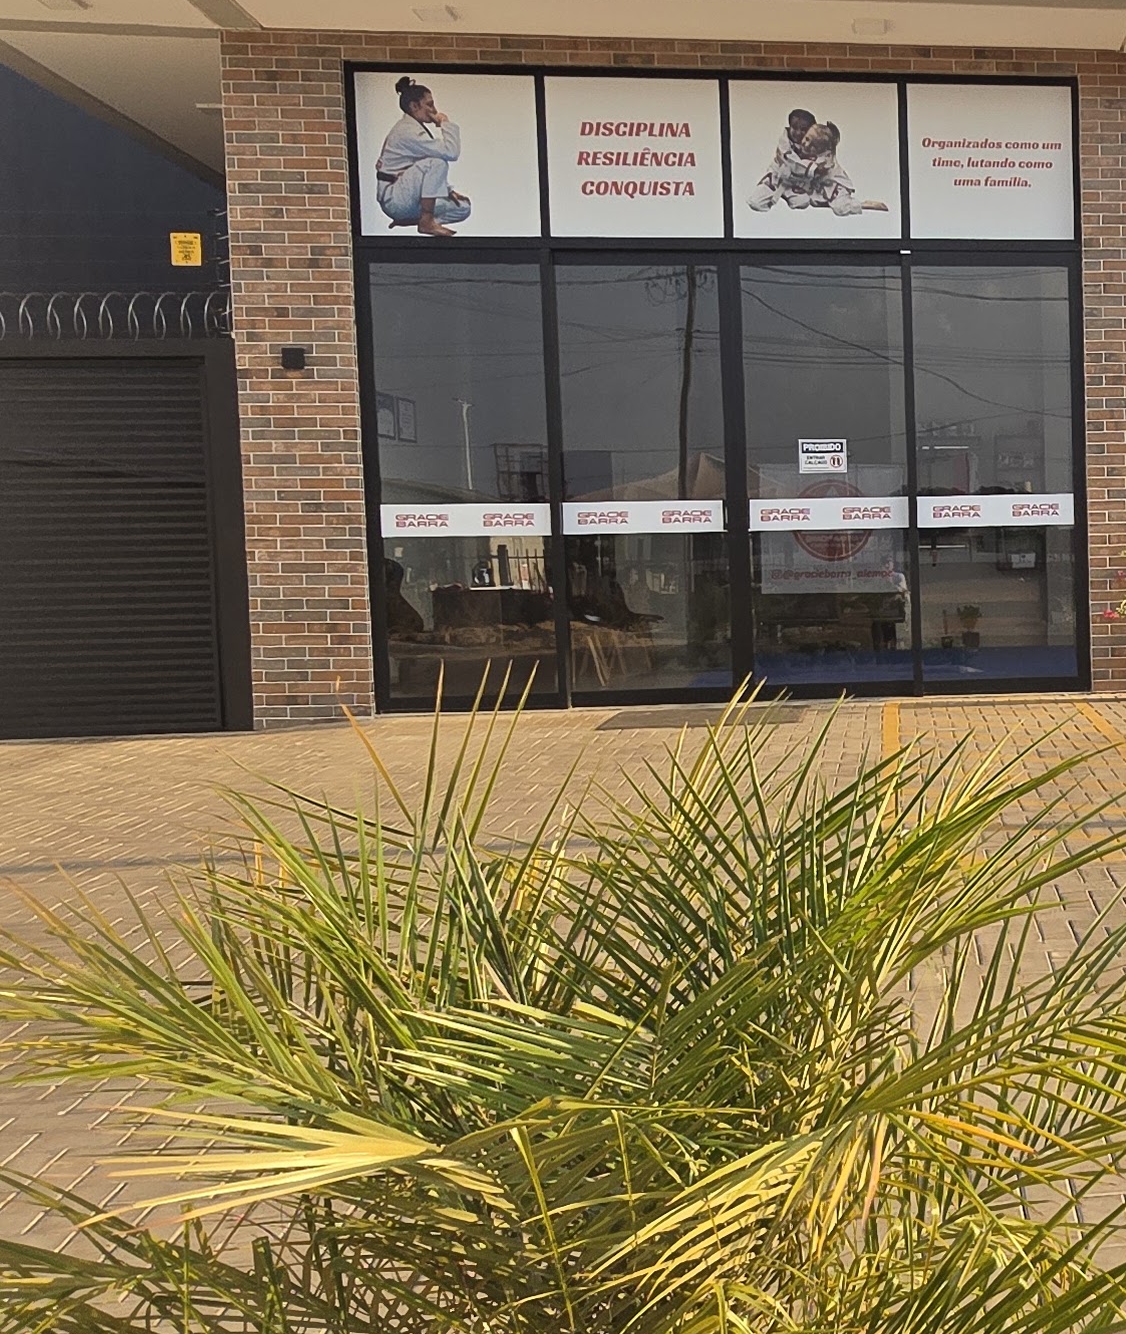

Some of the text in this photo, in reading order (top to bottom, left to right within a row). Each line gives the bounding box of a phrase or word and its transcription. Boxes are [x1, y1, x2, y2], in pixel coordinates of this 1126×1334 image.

[579, 121, 691, 138] DISCIPLINA
[921, 137, 1062, 150] Organizados como um
[577, 147, 696, 166] RESILIÊNCIA
[932, 157, 1053, 169] time, lutando como
[953, 178, 981, 186] uma
[581, 180, 695, 198] CONQUISTA
[803, 443, 842, 452] PROIBIDO
[842, 506, 891, 514] GRACIE
[932, 504, 980, 512] GRACIE
